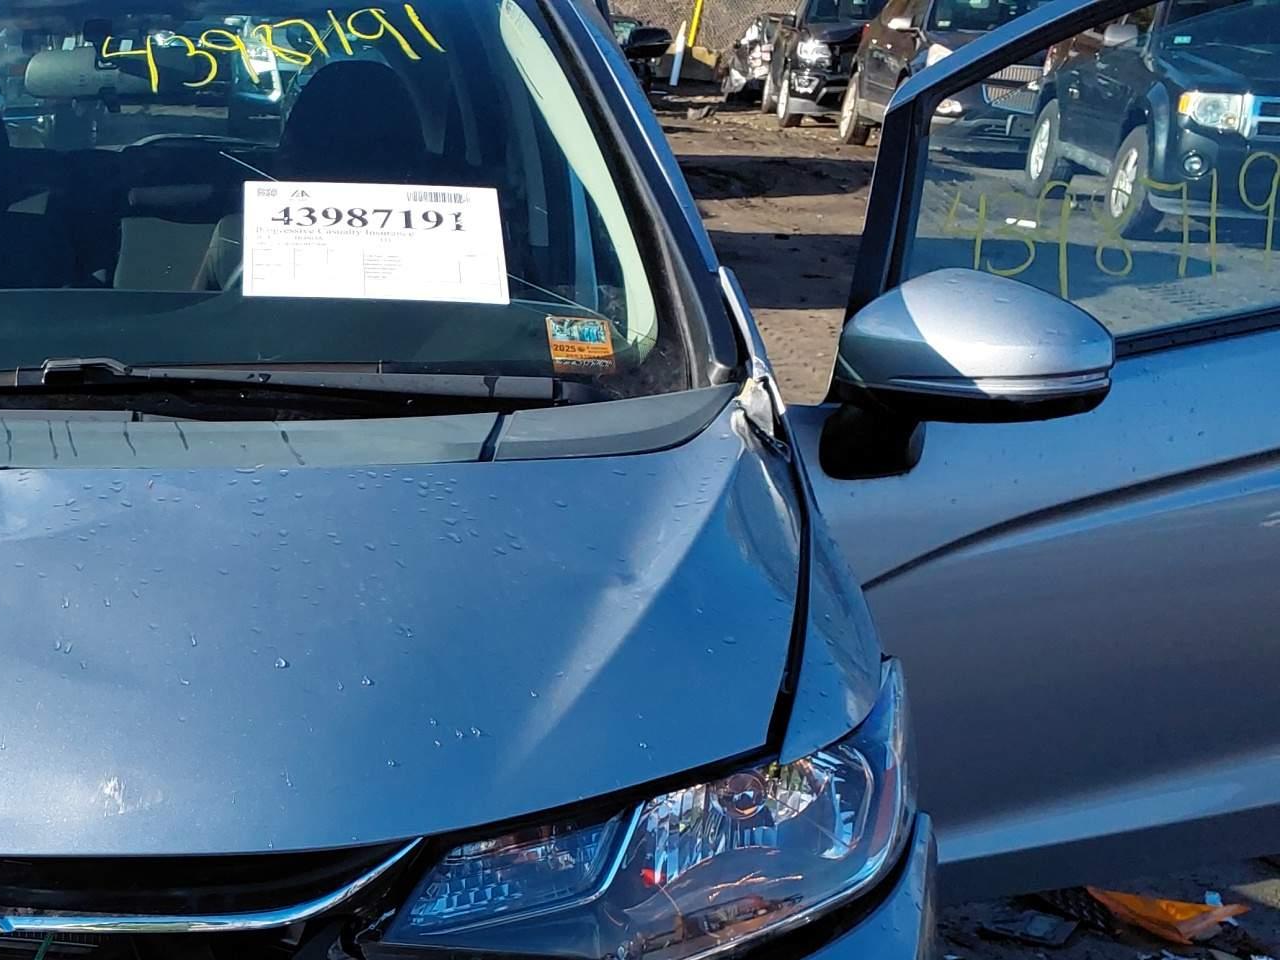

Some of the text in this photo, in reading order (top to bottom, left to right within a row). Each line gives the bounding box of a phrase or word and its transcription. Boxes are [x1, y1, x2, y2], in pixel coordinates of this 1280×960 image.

[101, 3, 446, 94] 43987191
[271, 206, 466, 232] 43987191
[553, 344, 577, 353] 2025
